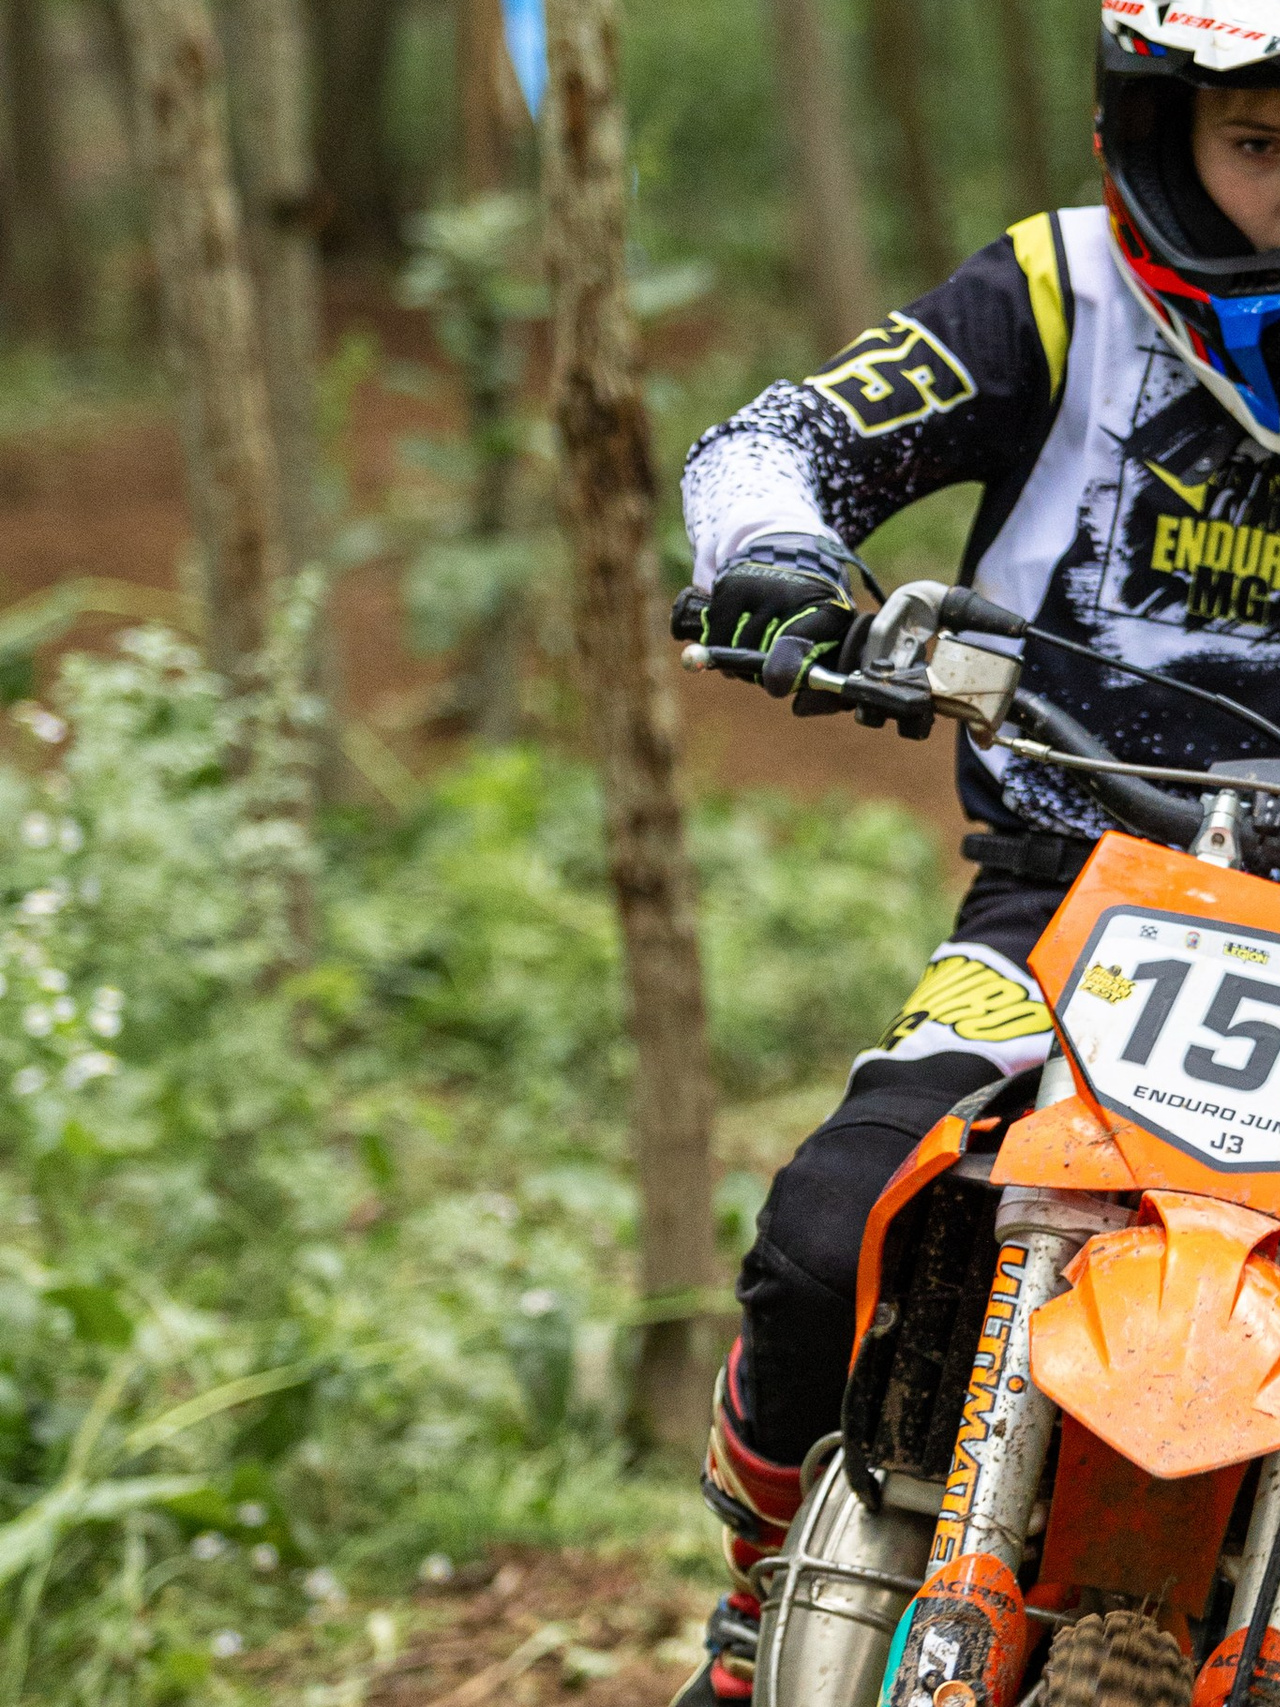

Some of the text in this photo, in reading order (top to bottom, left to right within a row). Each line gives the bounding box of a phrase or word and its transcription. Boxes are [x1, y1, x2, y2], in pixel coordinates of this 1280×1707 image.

[1189, 565, 1271, 628] MG
[1132, 1085, 1237, 1121] ENDURO
[1210, 1132, 1245, 1155] J3
